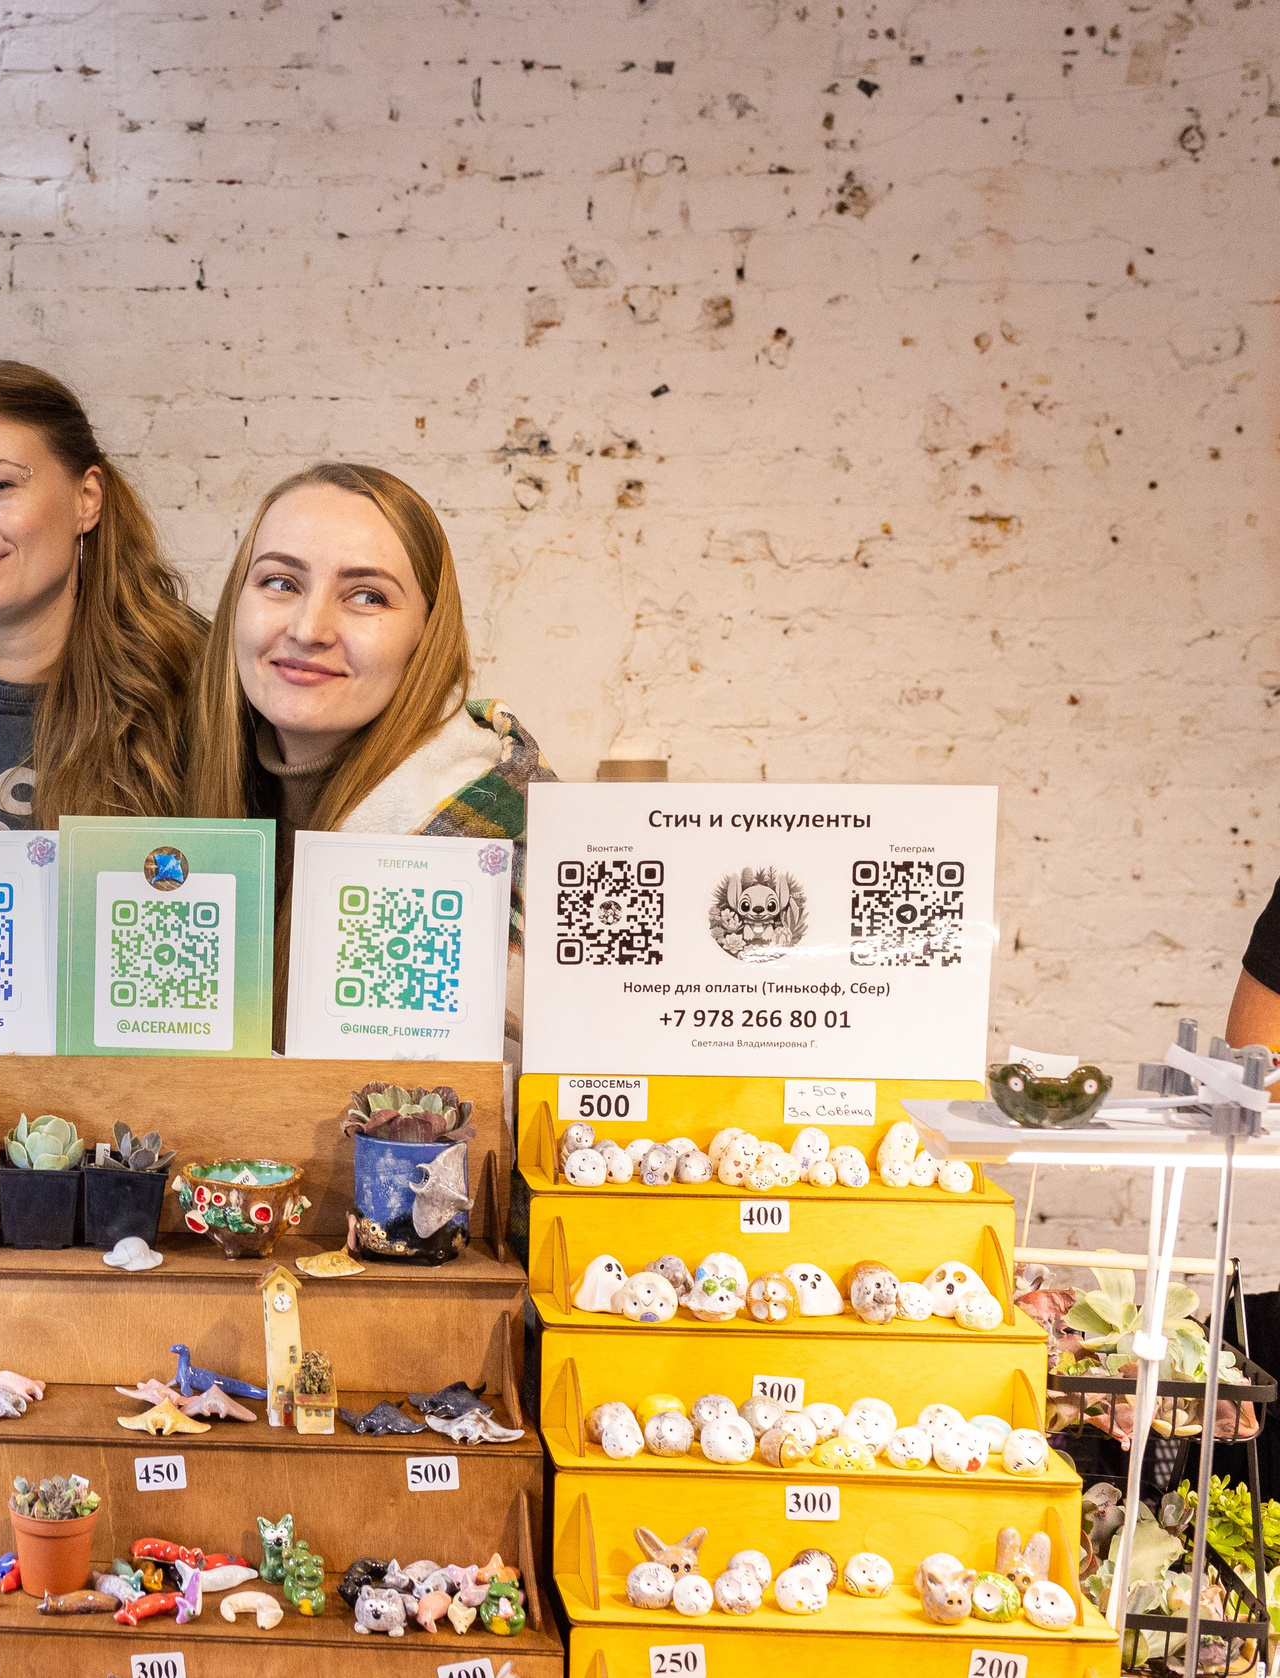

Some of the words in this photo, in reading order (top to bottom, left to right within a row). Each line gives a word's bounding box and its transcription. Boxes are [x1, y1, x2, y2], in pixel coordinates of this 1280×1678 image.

[648, 809, 701, 828] Стич
[709, 814, 723, 828] и
[730, 813, 871, 832] суккуленты
[586, 844, 634, 853] Вконтакте
[888, 844, 935, 855] Телеграм
[376, 858, 428, 870] ТЕЛЕГРАМ
[623, 981, 671, 995] Номер
[675, 984, 701, 997] для
[704, 984, 758, 996] оплаты
[762, 981, 846, 997] (Тинькофф,
[850, 982, 890, 997] Сбер)
[116, 1019, 211, 1035] @ACERAMICS
[659, 1009, 686, 1028] +7
[693, 1009, 734, 1028] 978
[741, 1009, 783, 1028] 266
[790, 1009, 817, 1028] 80
[824, 1010, 851, 1029] 01
[340, 1022, 451, 1039] @GINGER_FLOWER777
[691, 1038, 734, 1048] Светлана
[736, 1039, 807, 1050] Владимировна
[810, 1039, 818, 1048] Г.
[568, 1079, 641, 1089] СОВОСЕМЬЯ
[812, 1085, 836, 1097] 50
[578, 1094, 630, 1118] 500
[742, 1206, 782, 1227] 400
[138, 1462, 178, 1485] 450
[409, 1462, 451, 1484] 500
[788, 1492, 832, 1513] 300
[135, 1659, 178, 1678] 300
[654, 1651, 698, 1674] 250
[972, 1656, 1019, 1678] 200
